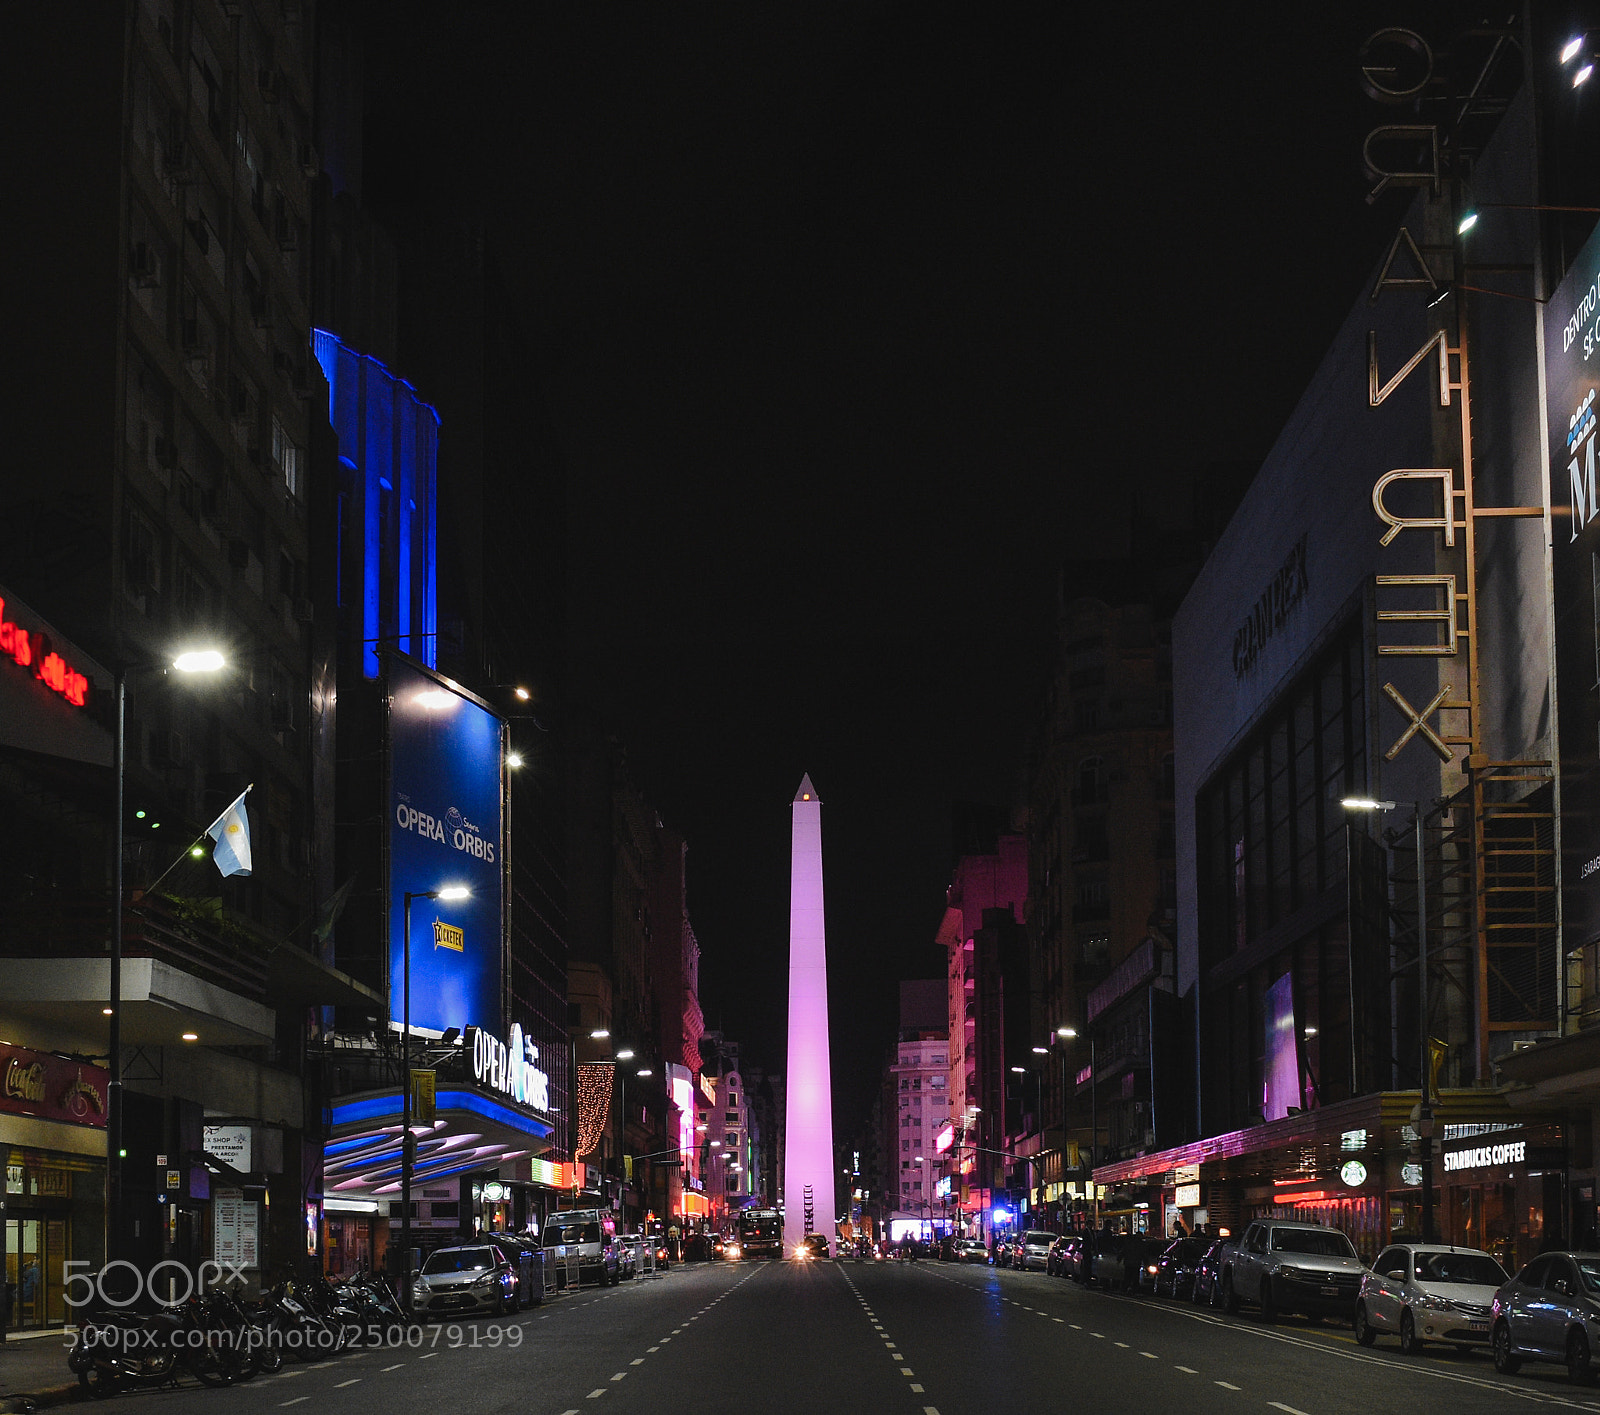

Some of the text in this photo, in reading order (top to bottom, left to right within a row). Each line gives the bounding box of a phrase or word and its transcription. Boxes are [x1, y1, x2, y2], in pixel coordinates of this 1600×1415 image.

[1563, 284, 1597, 354] DENTRO
[1583, 327, 1594, 361] SE
[396, 803, 495, 863] OPERA ORBIS
[473, 1026, 515, 1098] OPERA
[1443, 1141, 1526, 1172] STARBUCKS COFFEE
